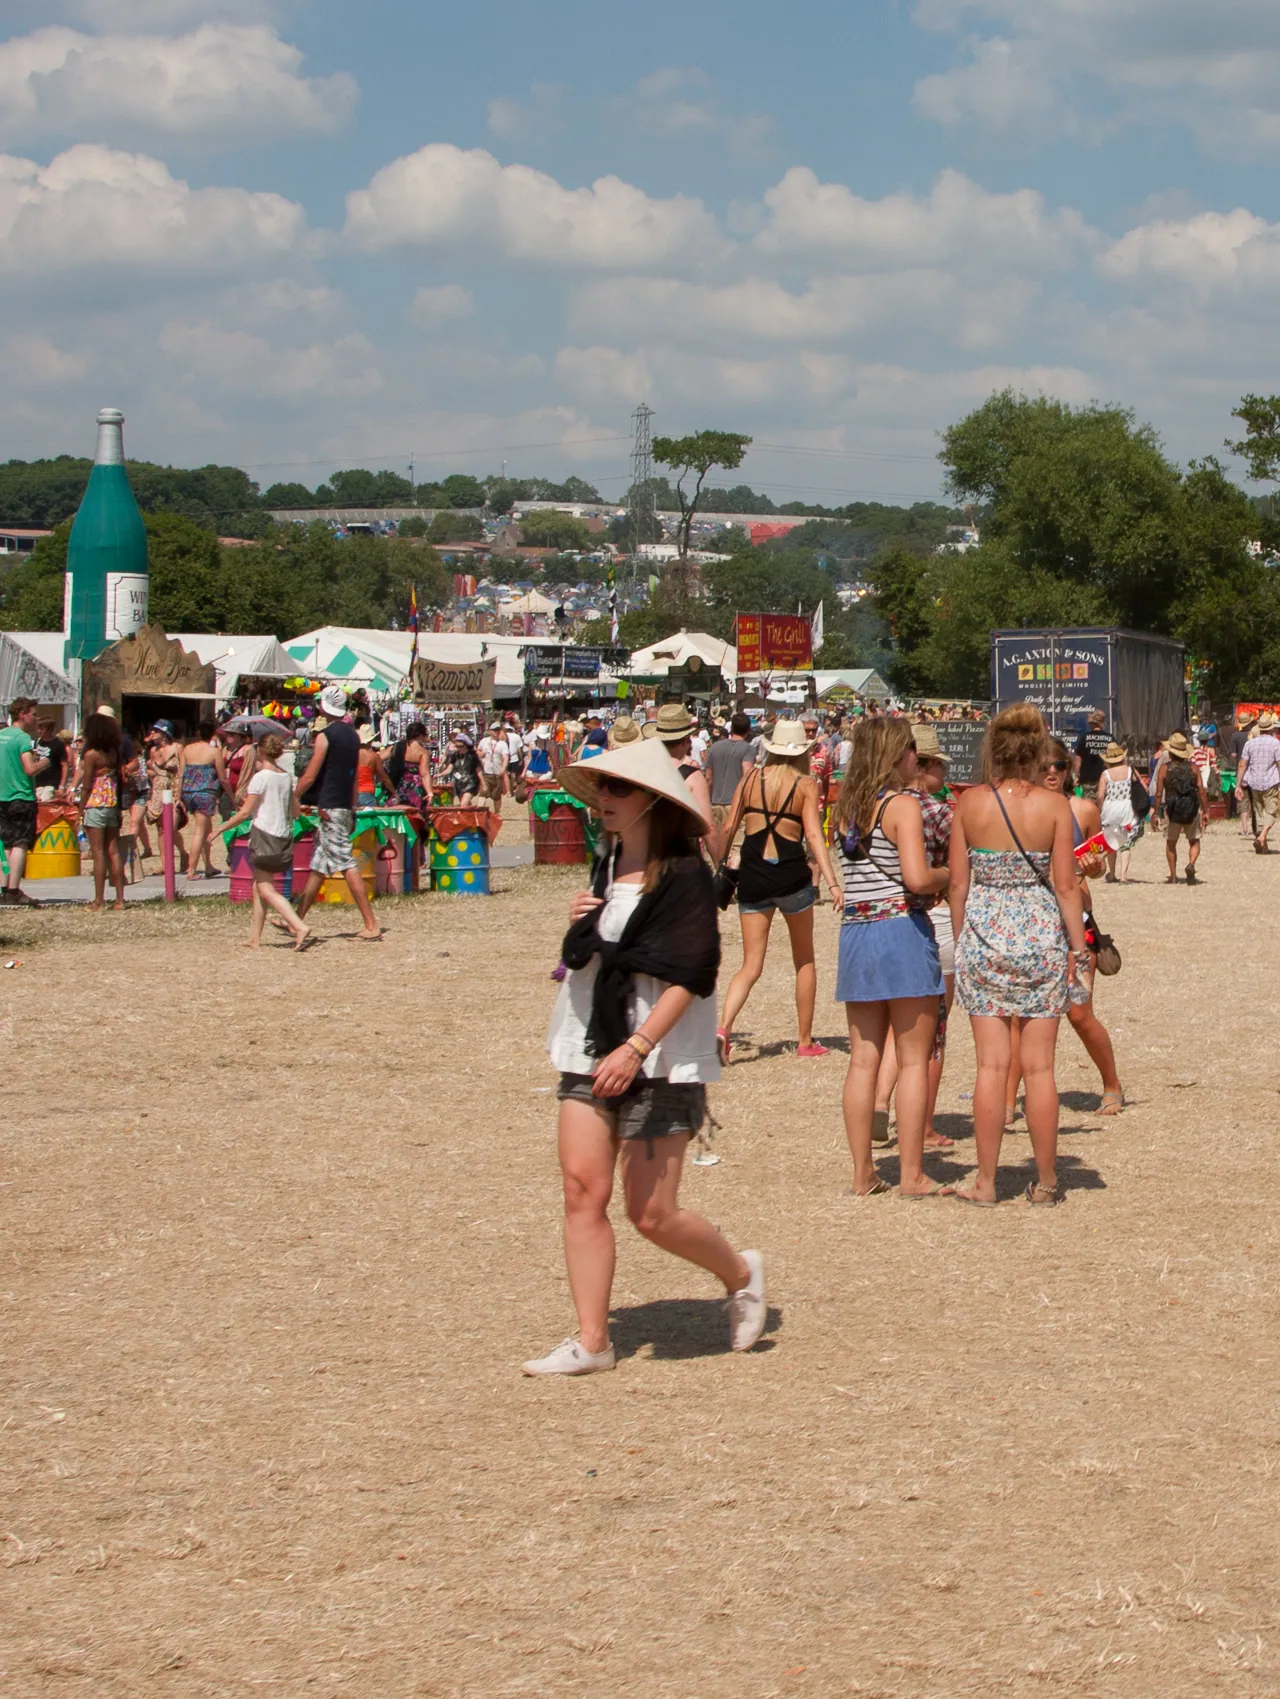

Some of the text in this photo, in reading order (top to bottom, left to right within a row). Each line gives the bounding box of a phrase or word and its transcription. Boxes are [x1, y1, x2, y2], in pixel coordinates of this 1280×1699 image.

[130, 590, 148, 605] WIN
[132, 609, 146, 623] BA
[766, 622, 782, 646] The
[784, 622, 806, 650] Grill
[1075, 650, 1105, 666] SONS
